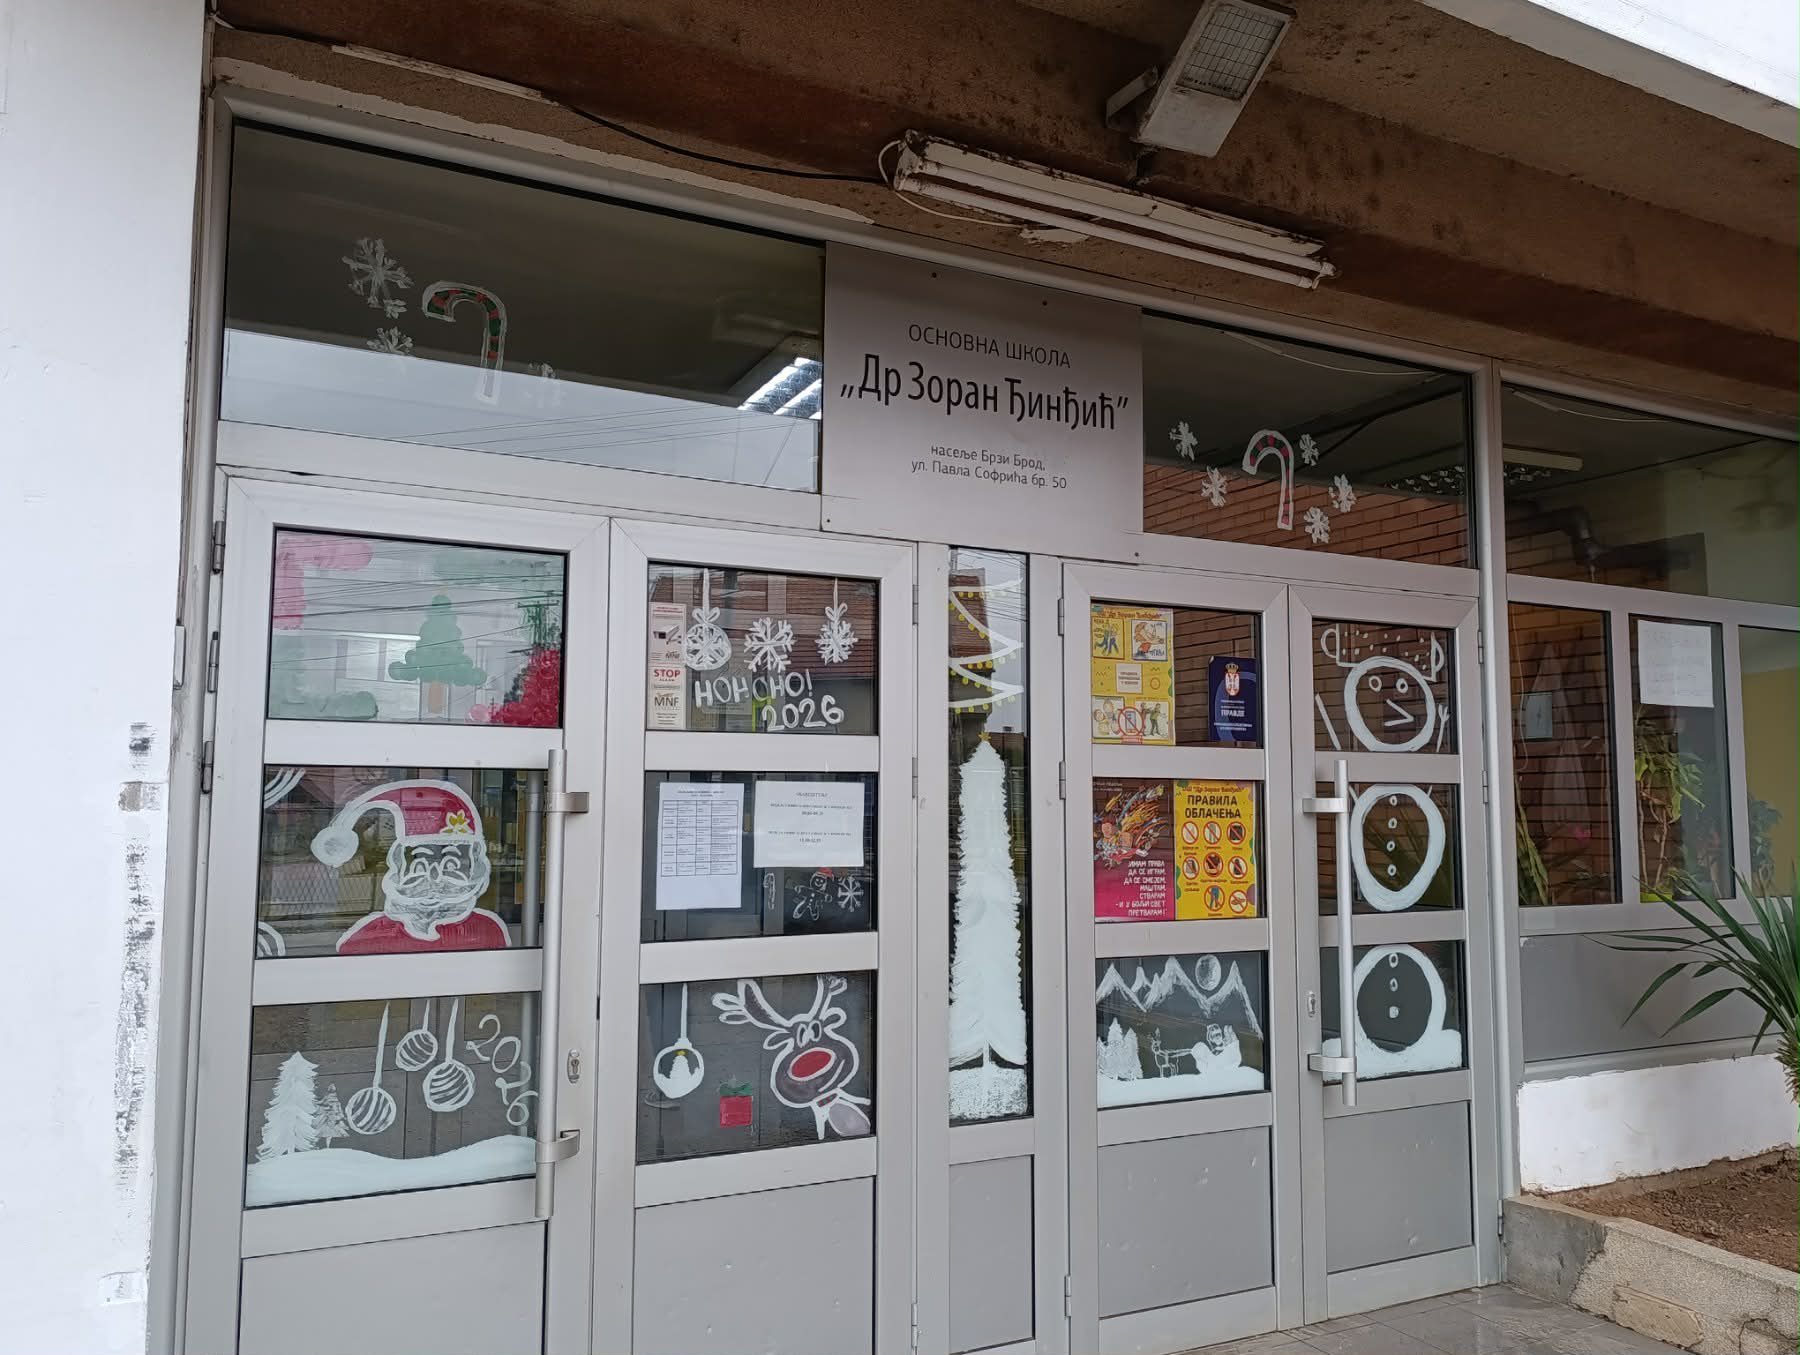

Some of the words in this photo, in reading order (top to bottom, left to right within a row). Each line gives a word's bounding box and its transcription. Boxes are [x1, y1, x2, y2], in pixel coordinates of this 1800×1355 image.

[908, 324, 1000, 357] ОСНОВНА
[1006, 341, 1071, 369] ШКОЛА
[907, 361, 998, 416] Зоран
[930, 445, 978, 461] насеље
[981, 449, 1010, 465] Брзи
[911, 460, 928, 474] ул.
[932, 460, 970, 477] Павла
[974, 466, 1028, 484] Софрића
[1031, 473, 1048, 489] бр.
[1052, 476, 1067, 489] 50
[654, 669, 681, 678] STOP
[654, 696, 680, 707] MNF
[761, 695, 845, 732] 2026
[1187, 794, 1238, 806] ПРАВИЛА
[1184, 807, 1242, 819] ОБЛАЧЕЊА
[1128, 868, 1137, 876] ДА
[1123, 877, 1132, 885] ДА
